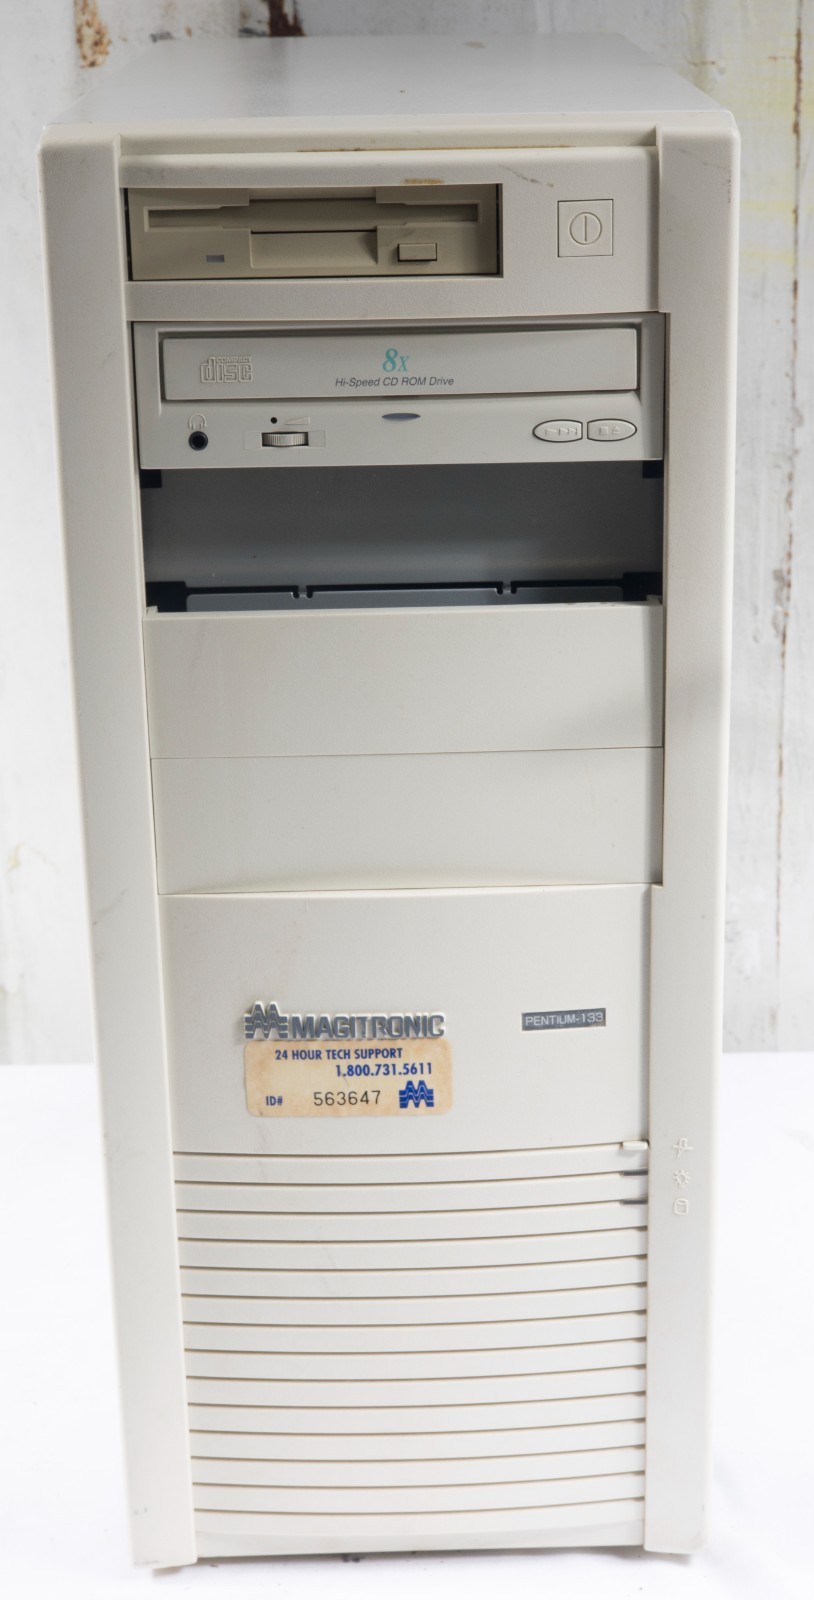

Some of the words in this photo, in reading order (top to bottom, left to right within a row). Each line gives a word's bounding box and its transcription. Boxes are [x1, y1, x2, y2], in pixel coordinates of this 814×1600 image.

[335, 377, 381, 388] Hi-Speed
[382, 377, 399, 387] CD
[401, 376, 427, 386] ROM
[428, 376, 455, 386] Drive
[291, 1012, 447, 1040] MAGITRONIC
[525, 1011, 604, 1026] PENTIUM-133
[275, 1050, 289, 1061] 24
[292, 1049, 322, 1061] HOUR
[326, 1049, 351, 1060] TECH
[354, 1047, 404, 1060] SUPPORT
[335, 1062, 433, 1077] 1.800.731.5611
[265, 1095, 284, 1107] ID#
[313, 1089, 382, 1107] 563647
